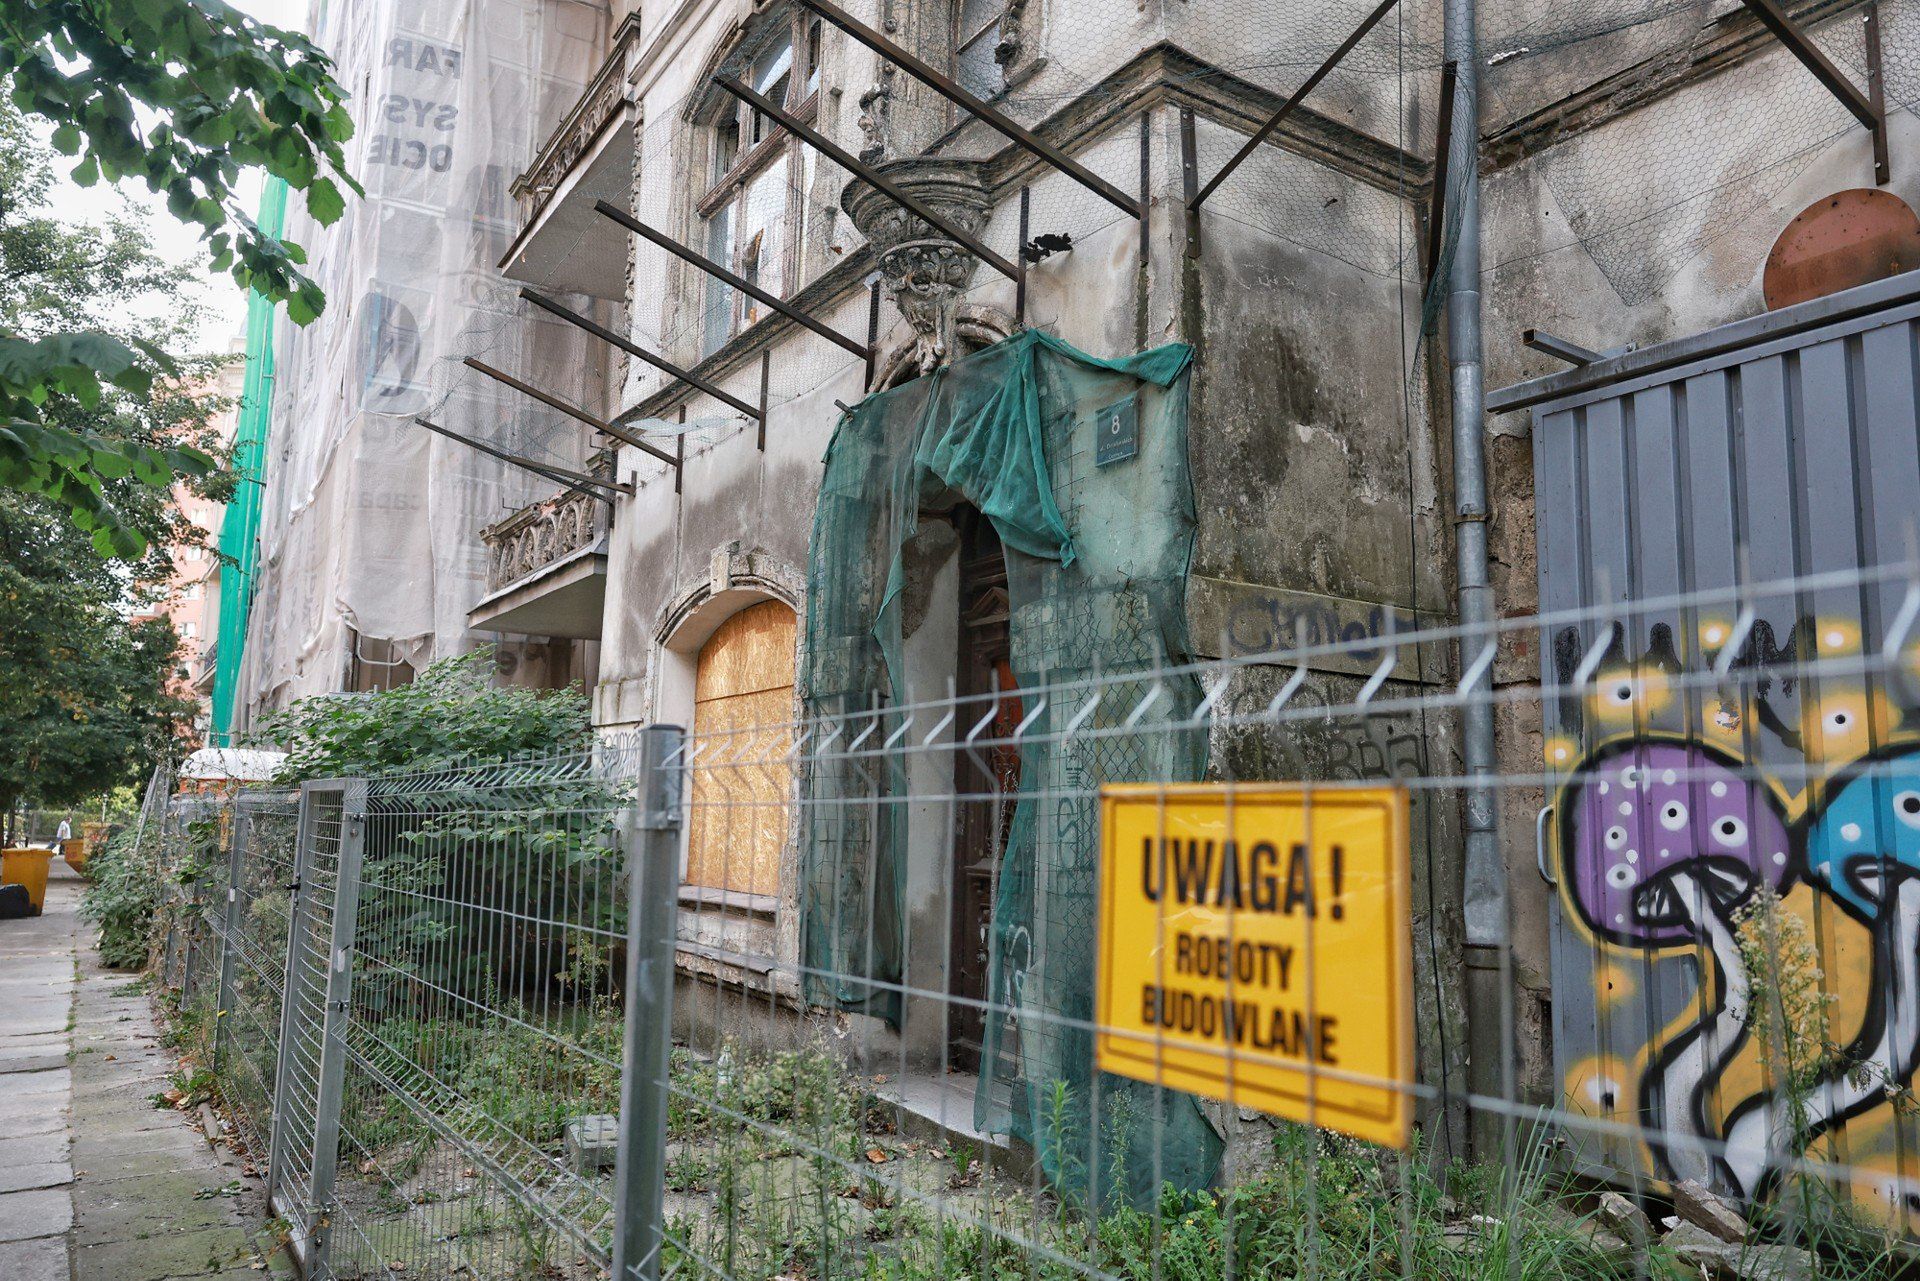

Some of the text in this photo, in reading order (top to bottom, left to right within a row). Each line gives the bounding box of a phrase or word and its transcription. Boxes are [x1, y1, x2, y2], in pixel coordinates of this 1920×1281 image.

[1111, 414, 1120, 435] 8
[1176, 932, 1294, 990] ROBOTY
[1142, 984, 1340, 1065] BUDOWLANE
